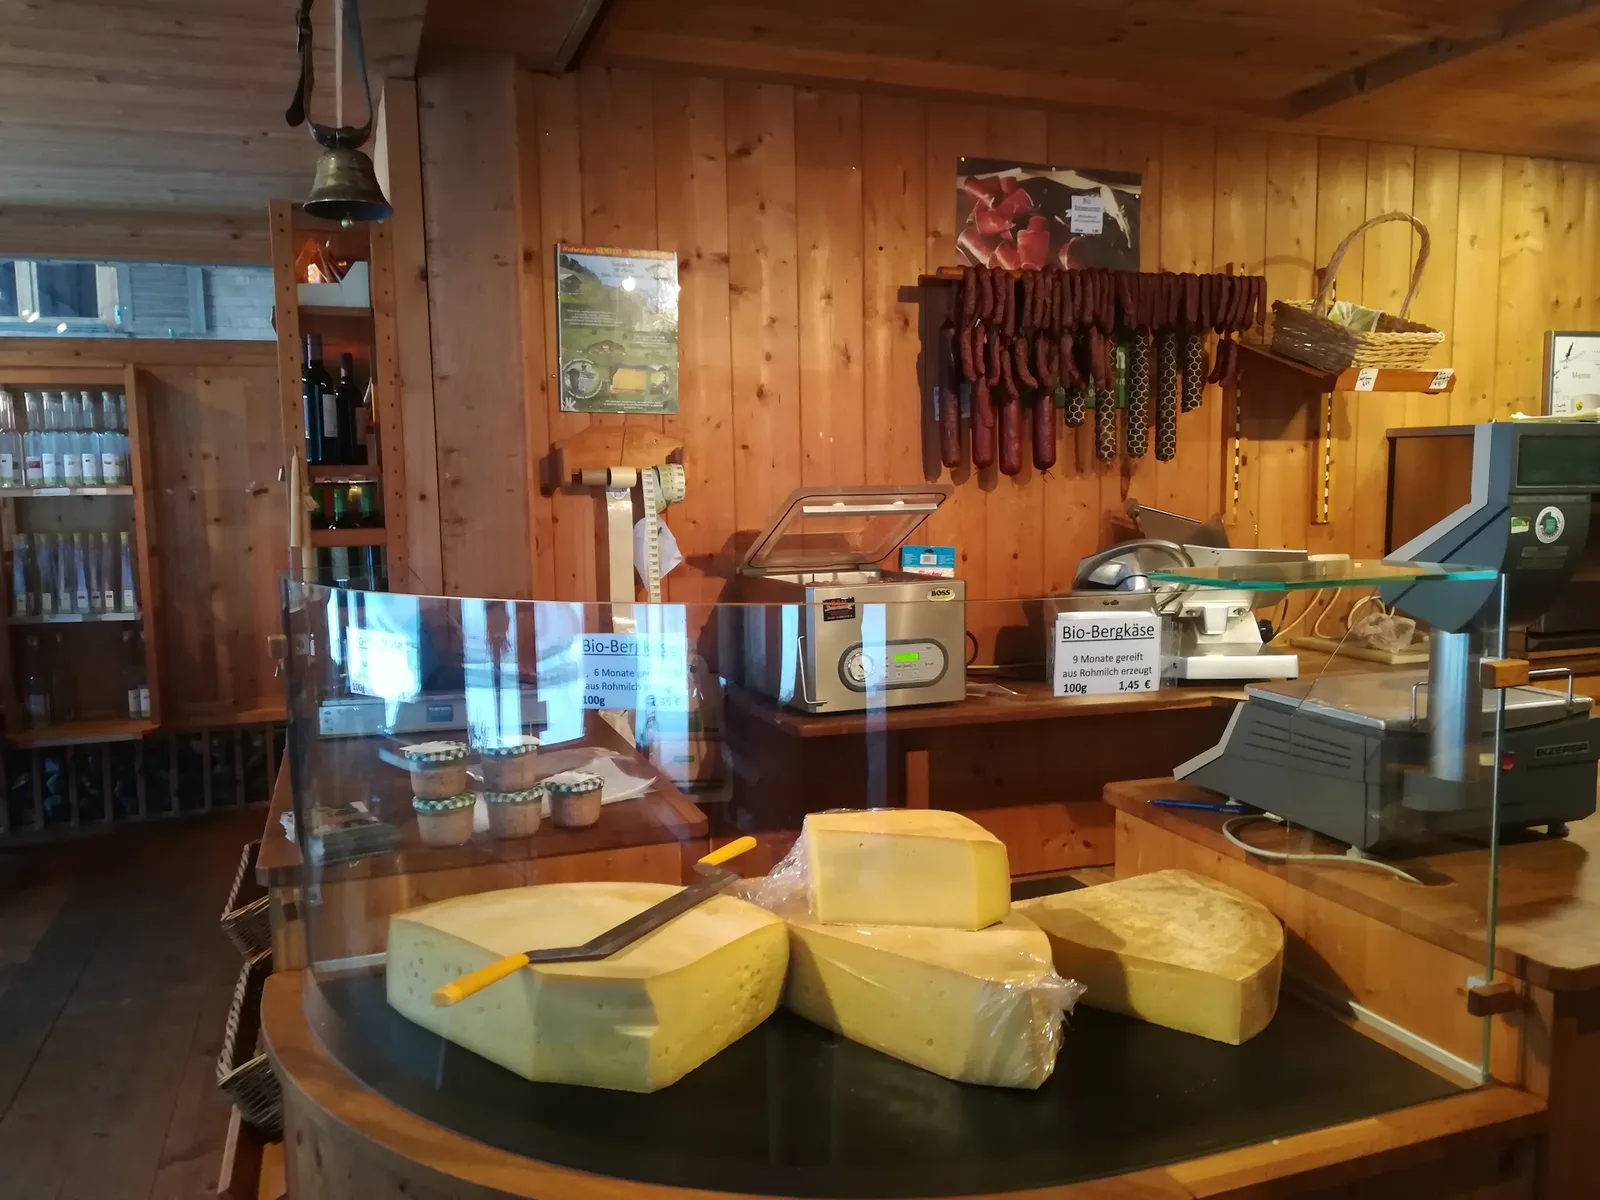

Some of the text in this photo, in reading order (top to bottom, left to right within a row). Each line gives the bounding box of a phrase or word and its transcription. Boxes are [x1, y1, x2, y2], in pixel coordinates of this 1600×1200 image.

[931, 589, 951, 597] BOSS
[1062, 623, 1155, 640] Bio-Bergkäse
[1072, 652, 1144, 664] 9 Monate gereift
[594, 668, 600, 677] 6
[601, 668, 635, 678] Monate
[1079, 667, 1119, 678] Rohmilch
[1121, 666, 1153, 677] erzeugt
[601, 681, 641, 692] Rohmilch
[1063, 679, 1151, 695] 100g 1,45 €
[583, 695, 606, 707] 100g
